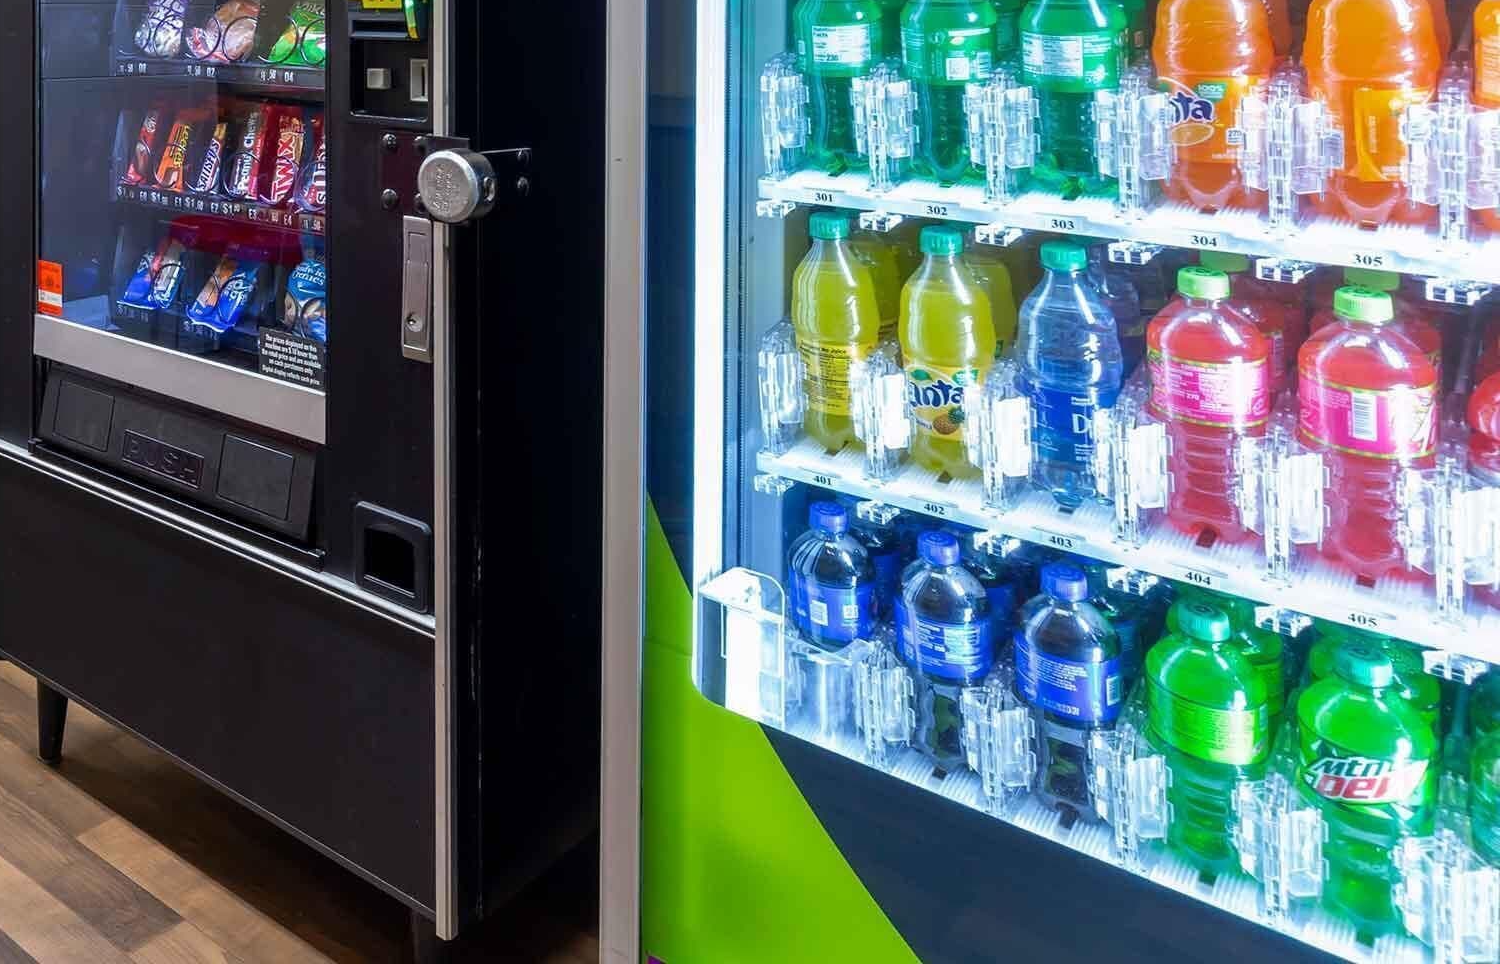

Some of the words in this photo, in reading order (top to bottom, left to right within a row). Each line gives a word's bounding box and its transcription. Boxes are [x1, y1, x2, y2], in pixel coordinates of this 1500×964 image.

[271, 136, 295, 204] TWIX
[815, 192, 834, 203] 301
[926, 205, 948, 216] 302
[1051, 219, 1075, 230] 303
[1190, 235, 1218, 247] 304
[1355, 253, 1383, 267] 305
[908, 379, 965, 408] anta
[813, 475, 833, 486] 401
[923, 503, 945, 515] 402
[1049, 536, 1073, 549] 403
[1184, 572, 1211, 585] 404
[1347, 613, 1378, 628] 405
[1311, 758, 1384, 778] Mtn
